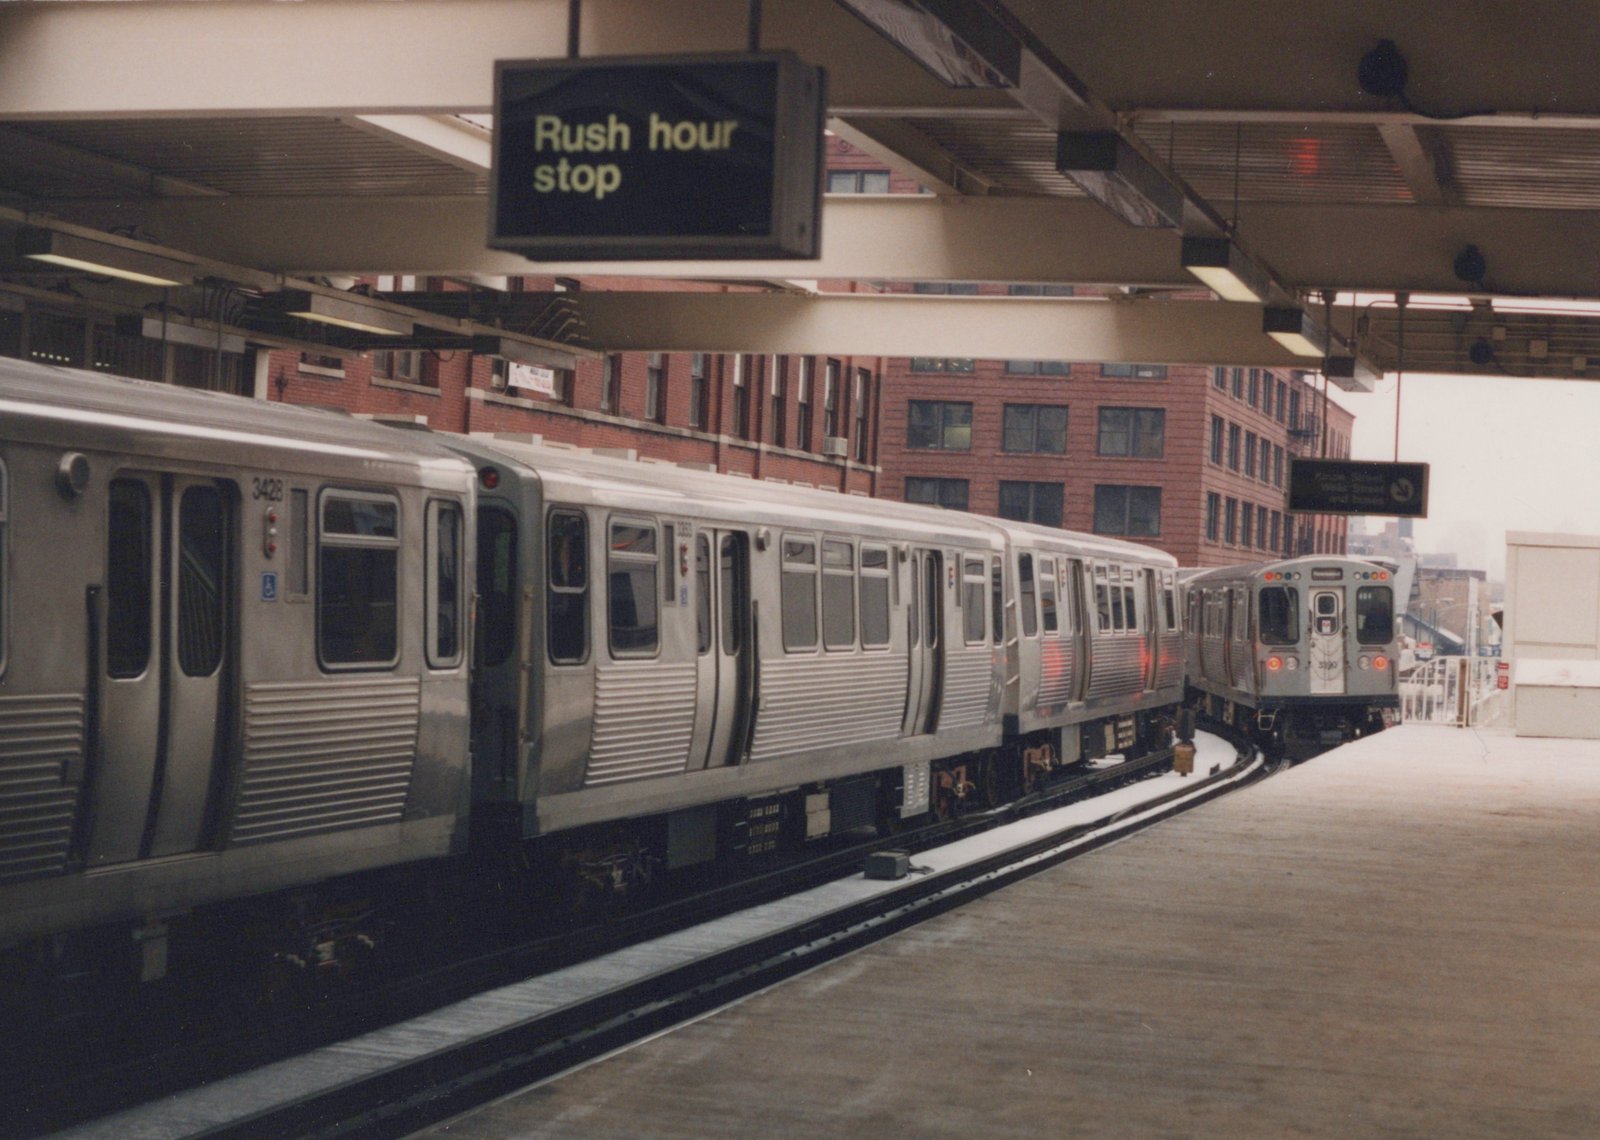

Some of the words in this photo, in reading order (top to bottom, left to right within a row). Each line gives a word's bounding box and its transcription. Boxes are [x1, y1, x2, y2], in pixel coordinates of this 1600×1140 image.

[534, 113, 631, 152] Rush
[649, 112, 738, 151] hour
[533, 157, 622, 200] stop
[252, 477, 284, 502] 3428
